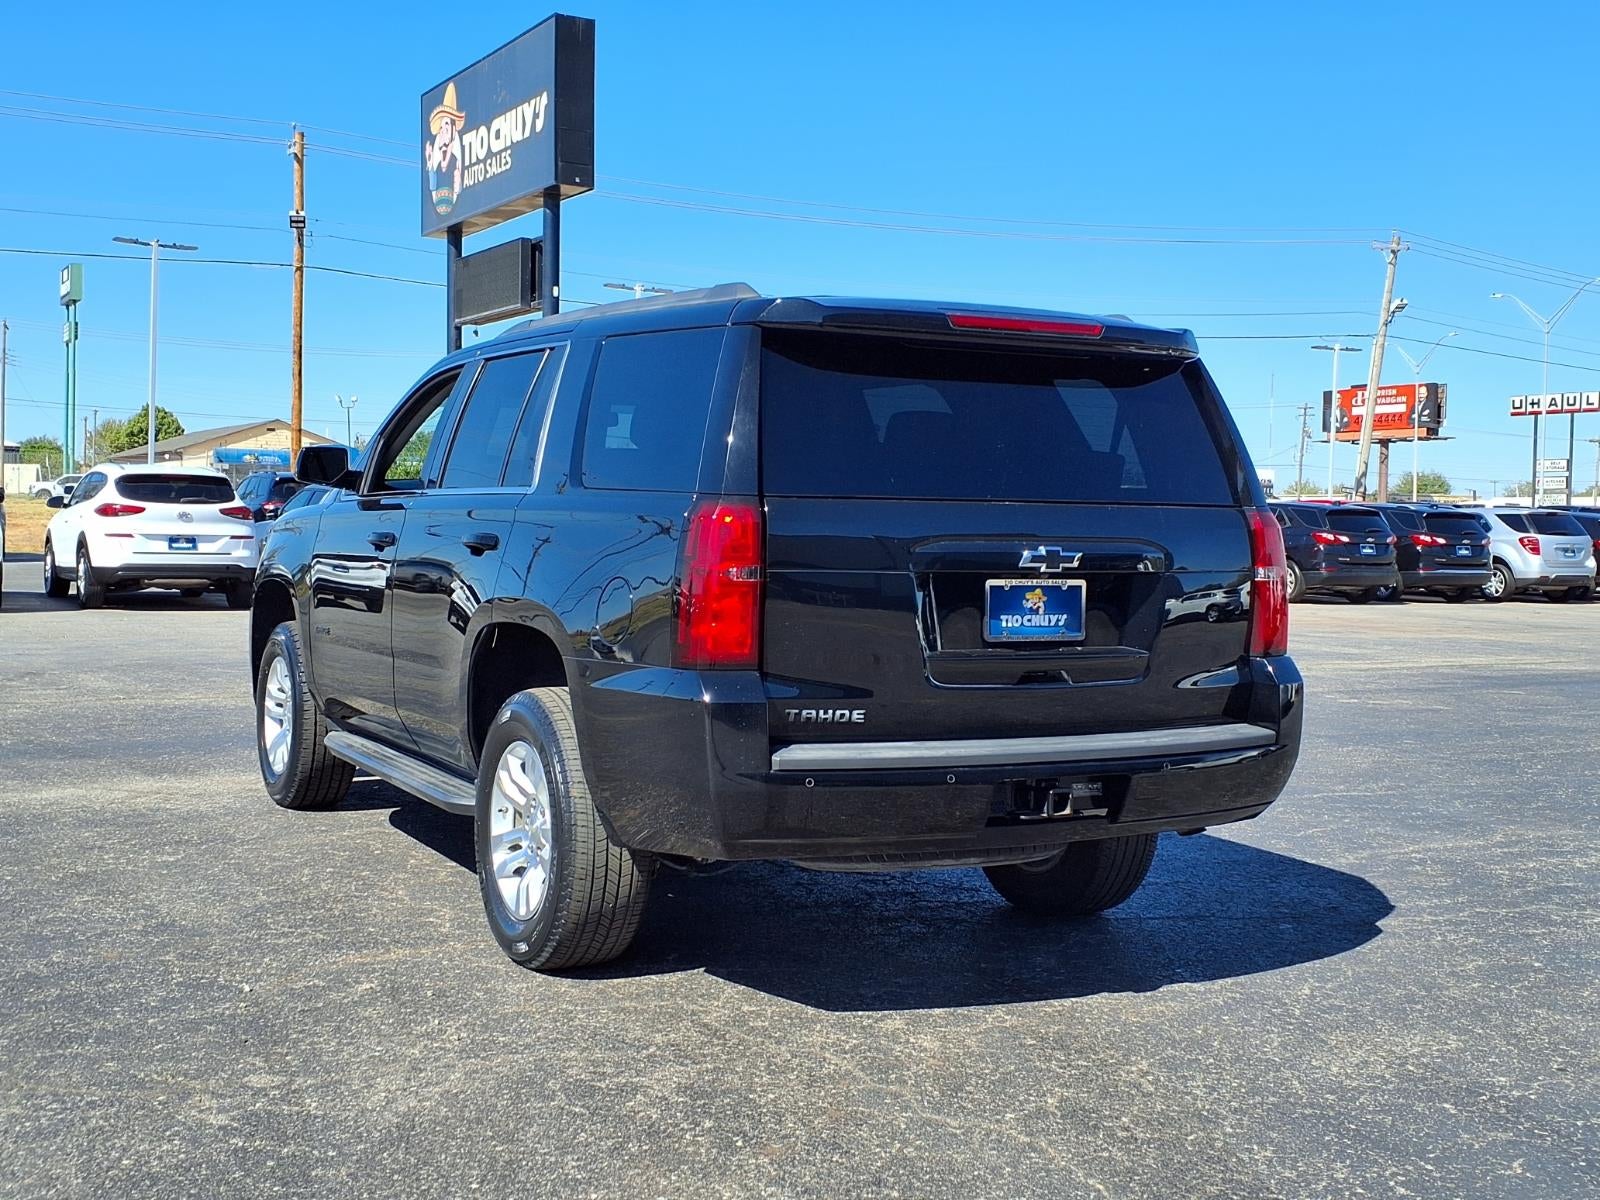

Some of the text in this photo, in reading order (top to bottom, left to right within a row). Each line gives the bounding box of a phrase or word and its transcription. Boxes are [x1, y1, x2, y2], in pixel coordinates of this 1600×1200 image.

[462, 91, 548, 167] TIO CHUY'S
[463, 149, 512, 189] AUTO SALES
[1377, 396, 1407, 404] VAUGHN
[1000, 614, 1067, 627] TIO CHUY'S
[785, 709, 866, 722] TAHOE
